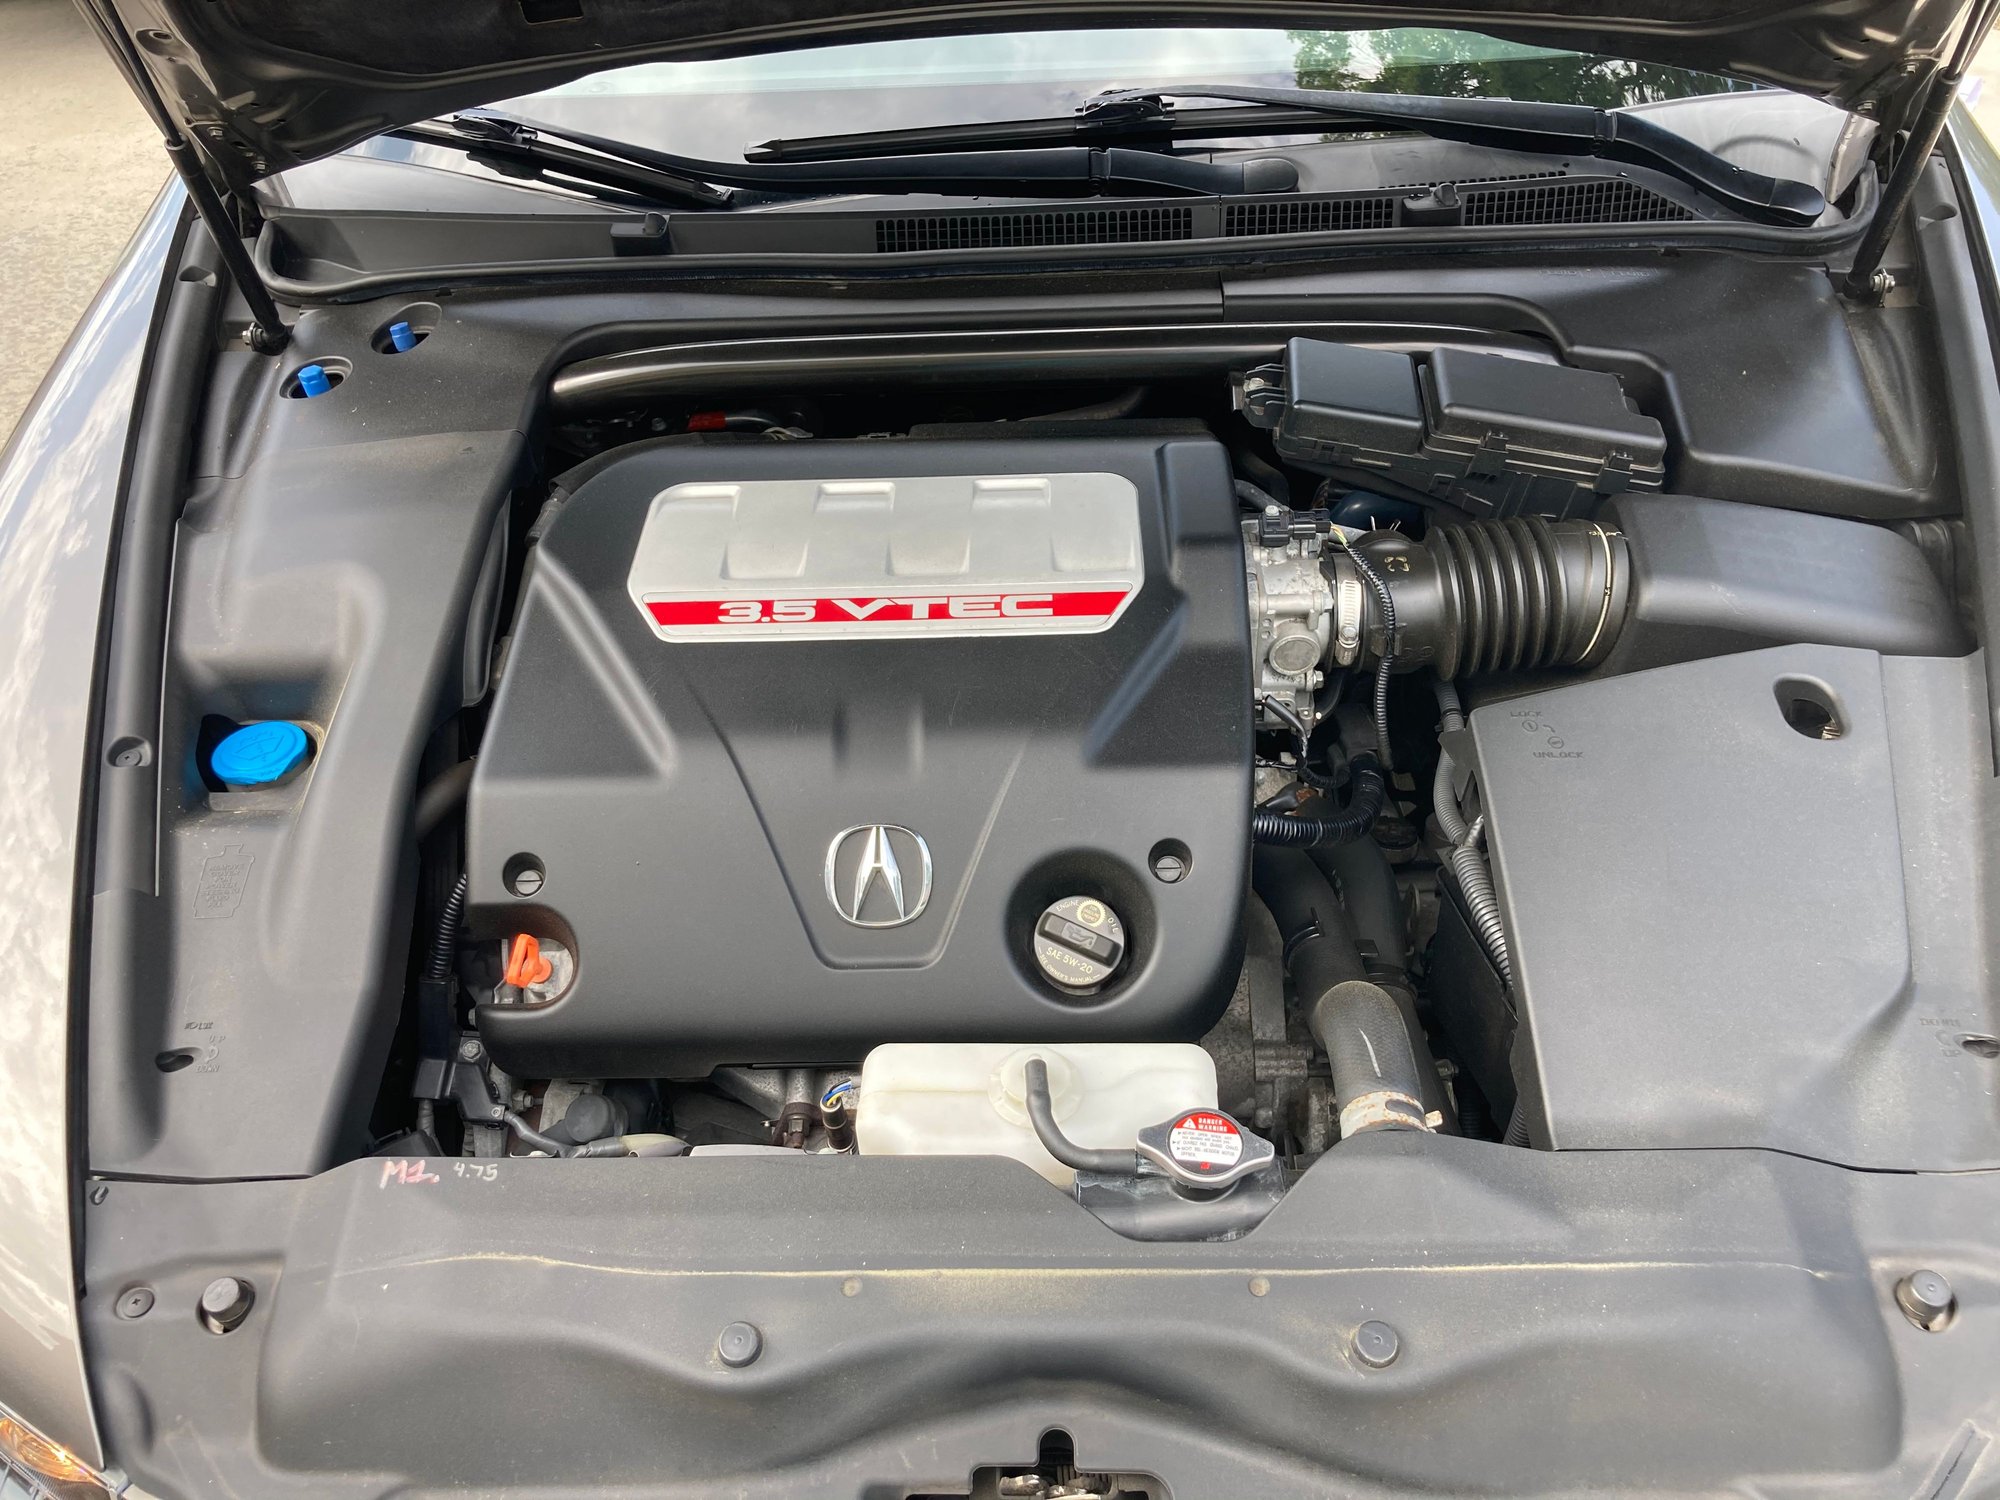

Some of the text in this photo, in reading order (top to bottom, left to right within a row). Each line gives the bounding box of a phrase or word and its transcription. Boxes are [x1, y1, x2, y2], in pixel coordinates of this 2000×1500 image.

[718, 594, 1053, 623] 3.5 VTEC
[1056, 900, 1120, 933] ENGINE OIL
[1046, 947, 1093, 974] SAE 5W-20
[453, 1162, 498, 1181] 4.75
